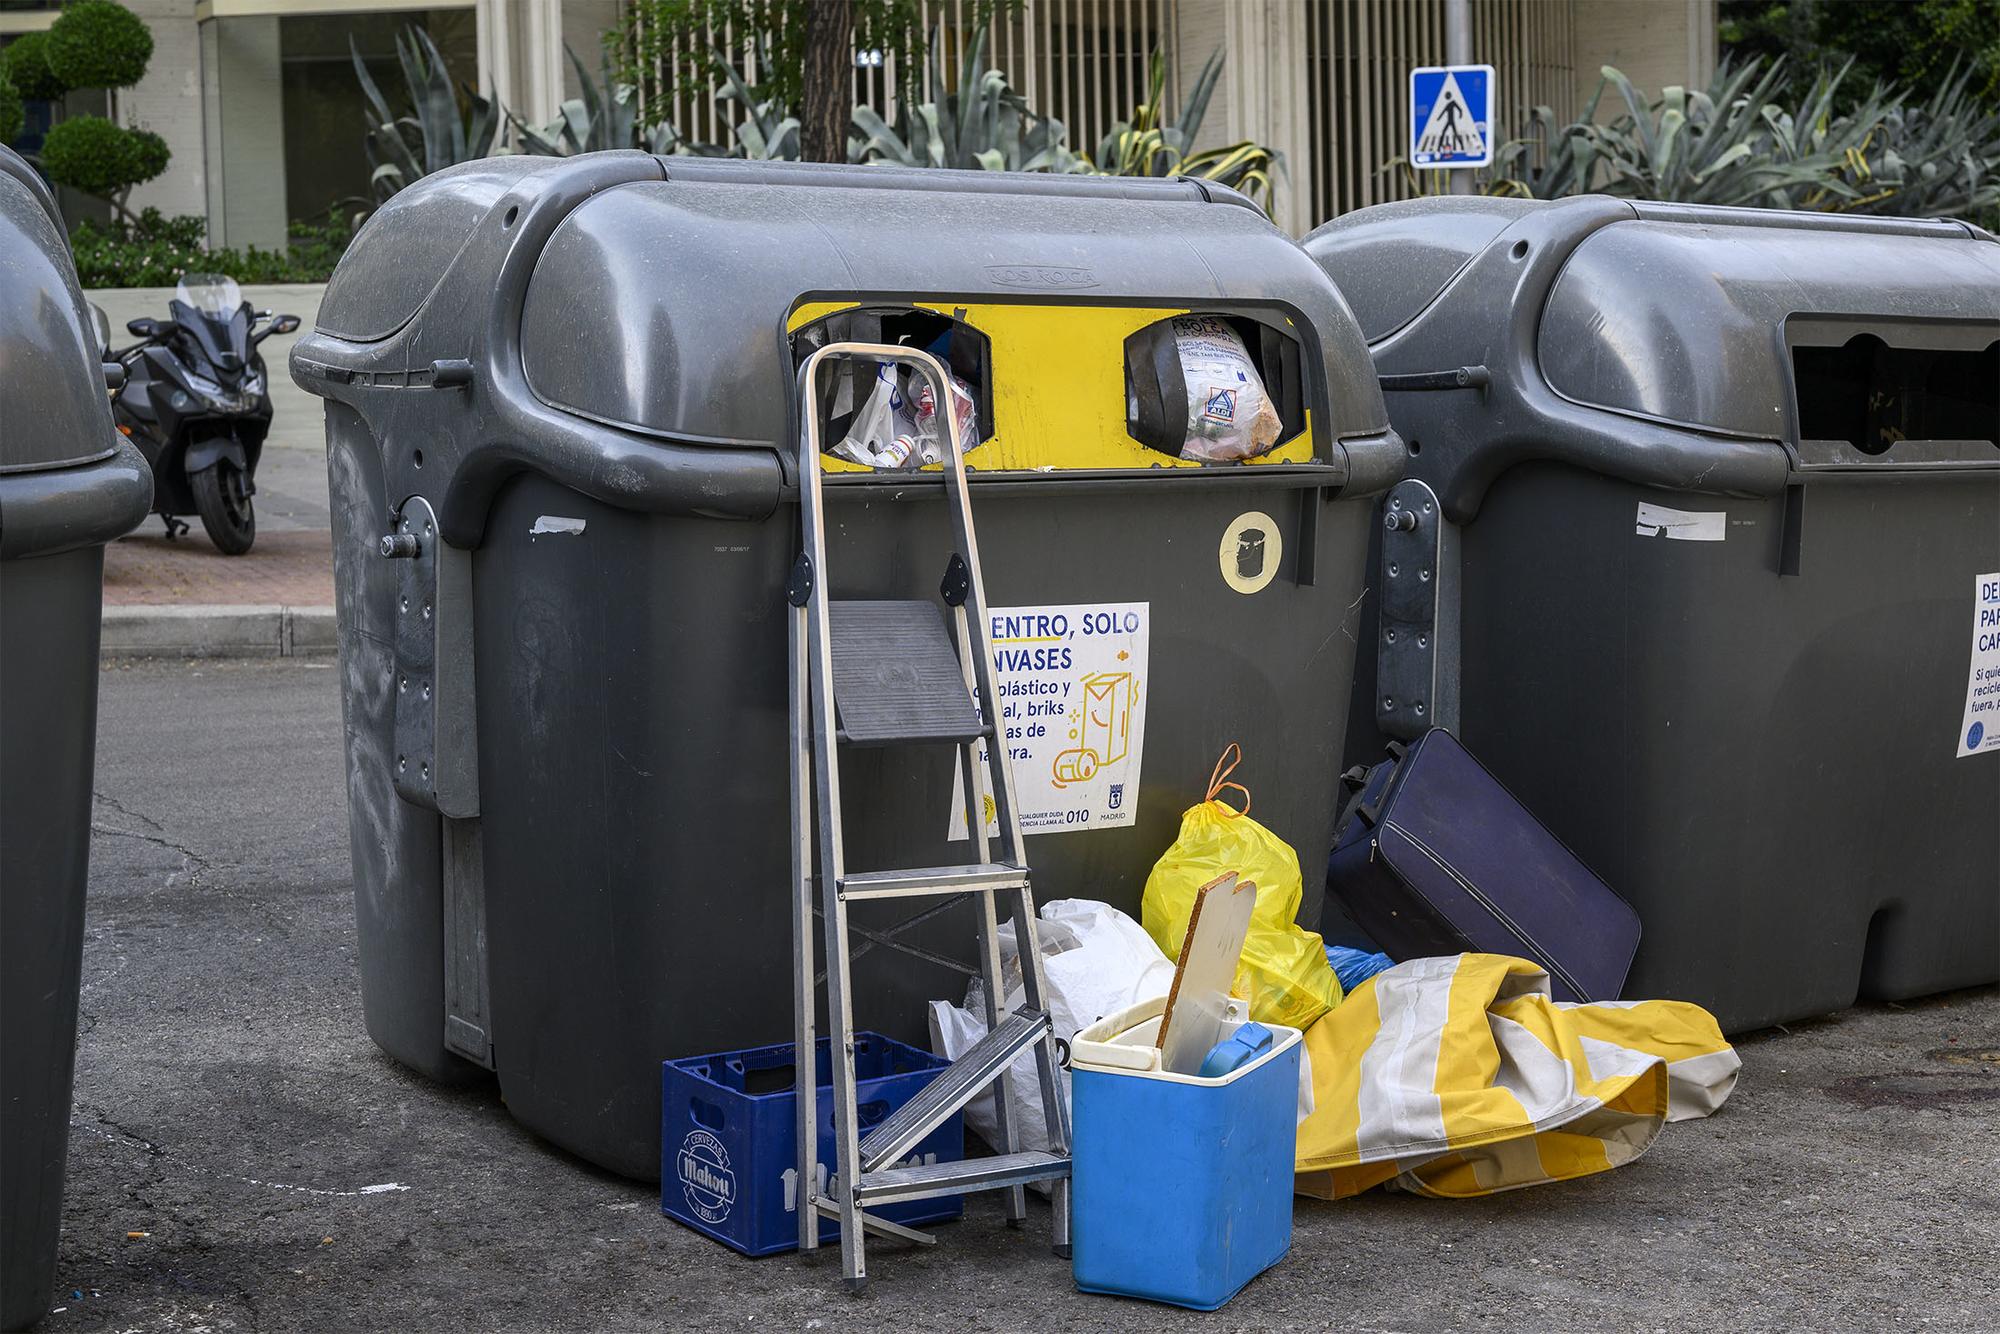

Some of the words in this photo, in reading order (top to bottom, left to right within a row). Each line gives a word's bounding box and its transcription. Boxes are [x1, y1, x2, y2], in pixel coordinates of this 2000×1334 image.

[1211, 407, 1230, 417] ALDI
[1982, 582, 2000, 601] DE
[992, 614, 1075, 640] ENTRO,
[1082, 611, 1140, 635] SOLO
[993, 647, 1073, 672] NVASES
[1975, 669, 1984, 681] Si
[1062, 682, 1071, 698] y
[1027, 700, 1064, 717] briks
[1026, 722, 1046, 738] de
[1039, 819, 1057, 827] LLAMA
[1066, 809, 1090, 824] 010
[1100, 812, 1126, 821] MADRID
[690, 1133, 723, 1156] CERVEZAS
[683, 1156, 730, 1197] Mahou
